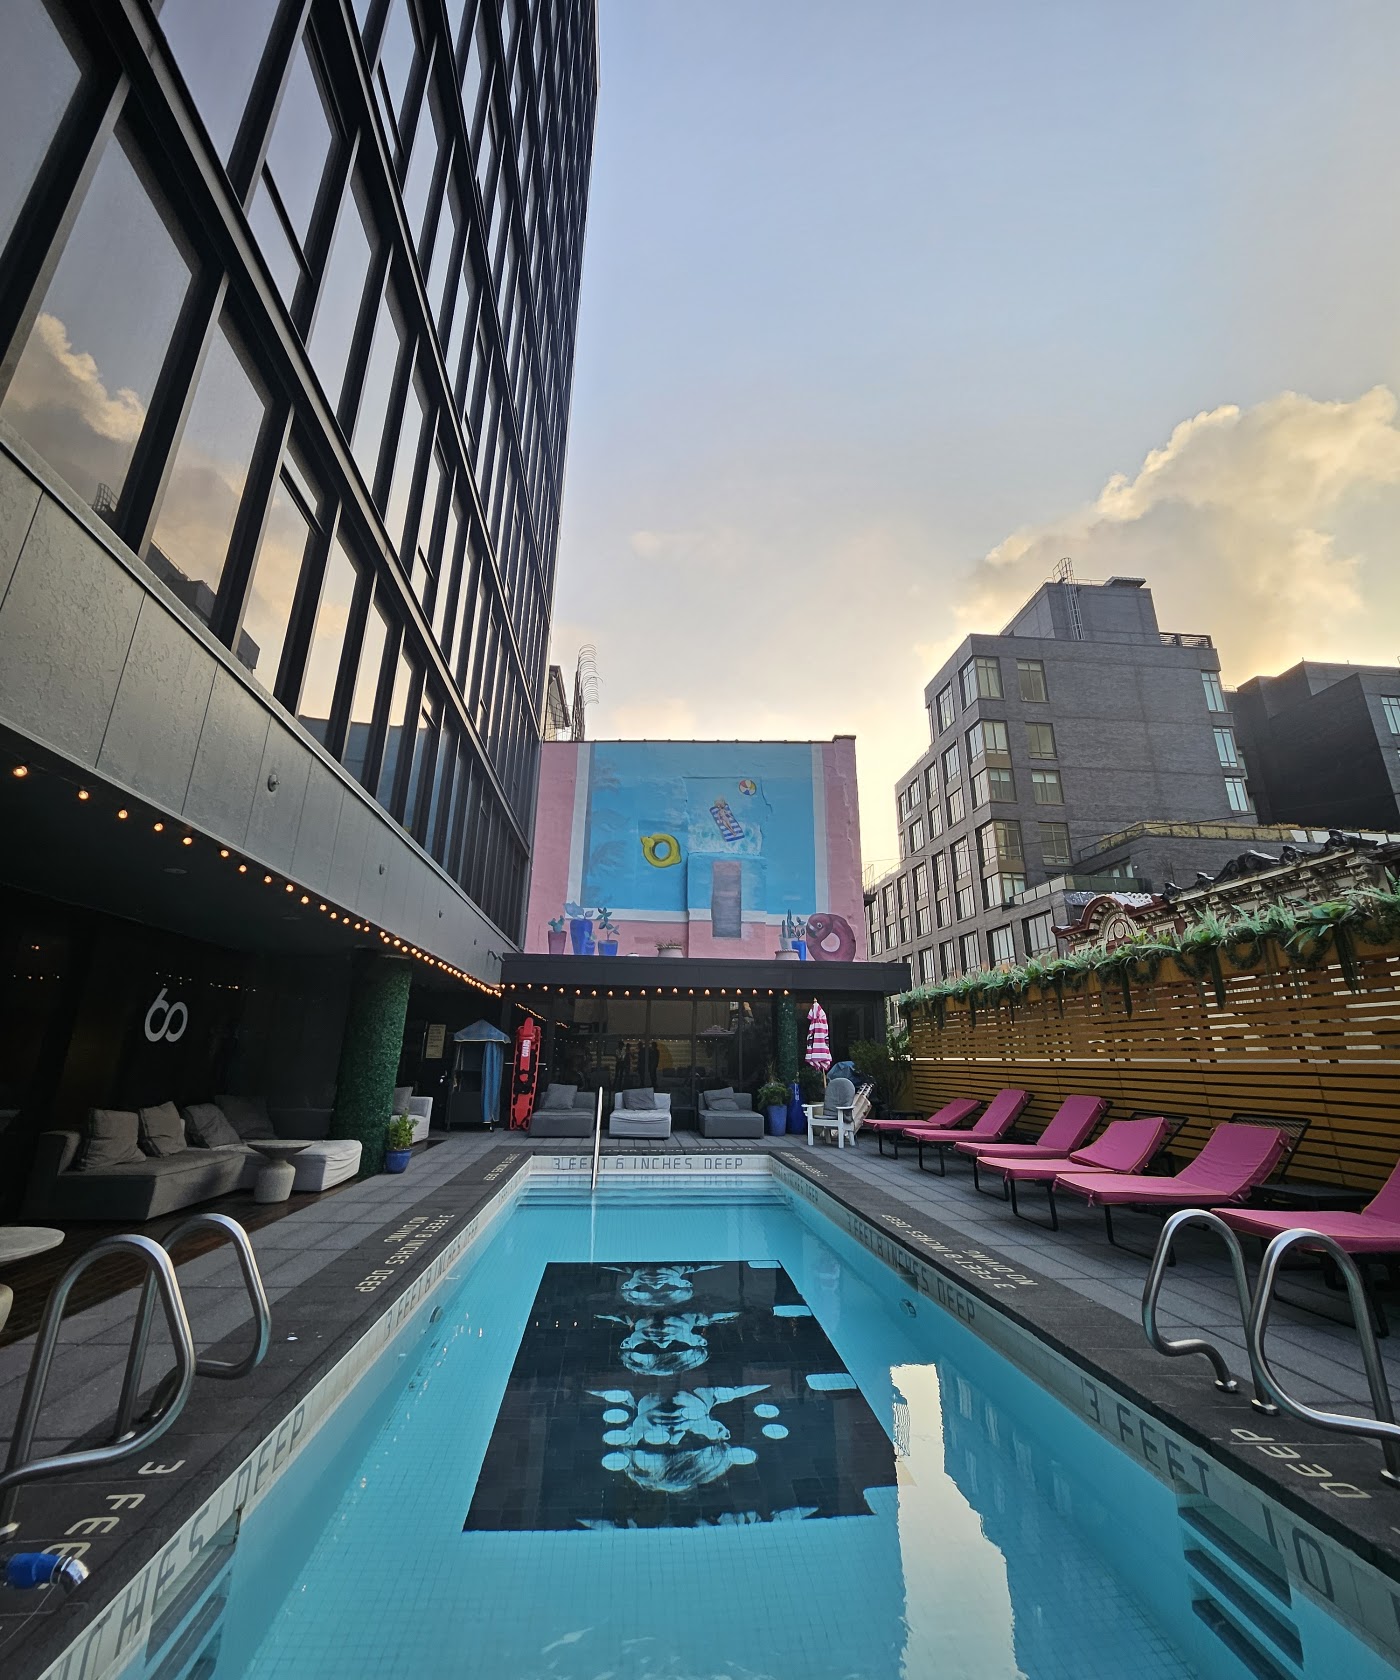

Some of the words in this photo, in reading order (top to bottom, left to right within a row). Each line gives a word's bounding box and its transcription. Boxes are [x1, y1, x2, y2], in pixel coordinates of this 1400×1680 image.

[553, 1157, 561, 1170] 3
[568, 1157, 608, 1170] FET
[616, 1157, 624, 1170] 6
[633, 1157, 693, 1170] INCHES
[704, 1157, 743, 1170] DEEP
[421, 1219, 449, 1233] FEET
[881, 1214, 912, 1229] DEEP
[384, 1239, 428, 1265] INCHES
[905, 1230, 953, 1253] INCHES
[854, 1219, 875, 1250] FEET
[937, 1276, 975, 1324] DEEP
[954, 1260, 1001, 1280] FEET
[961, 1249, 1015, 1273] DIVING
[354, 1269, 395, 1293] DEEP
[1006, 1274, 1039, 1286] NO
[395, 1276, 422, 1328] FEET
[137, 1459, 186, 1475] 3
[233, 1403, 305, 1512] DEEP
[1229, 1427, 1373, 1499] DEEP
[1083, 1380, 1100, 1424] 3
[1116, 1402, 1210, 1498] FEET
[1262, 1503, 1335, 1602] 10
